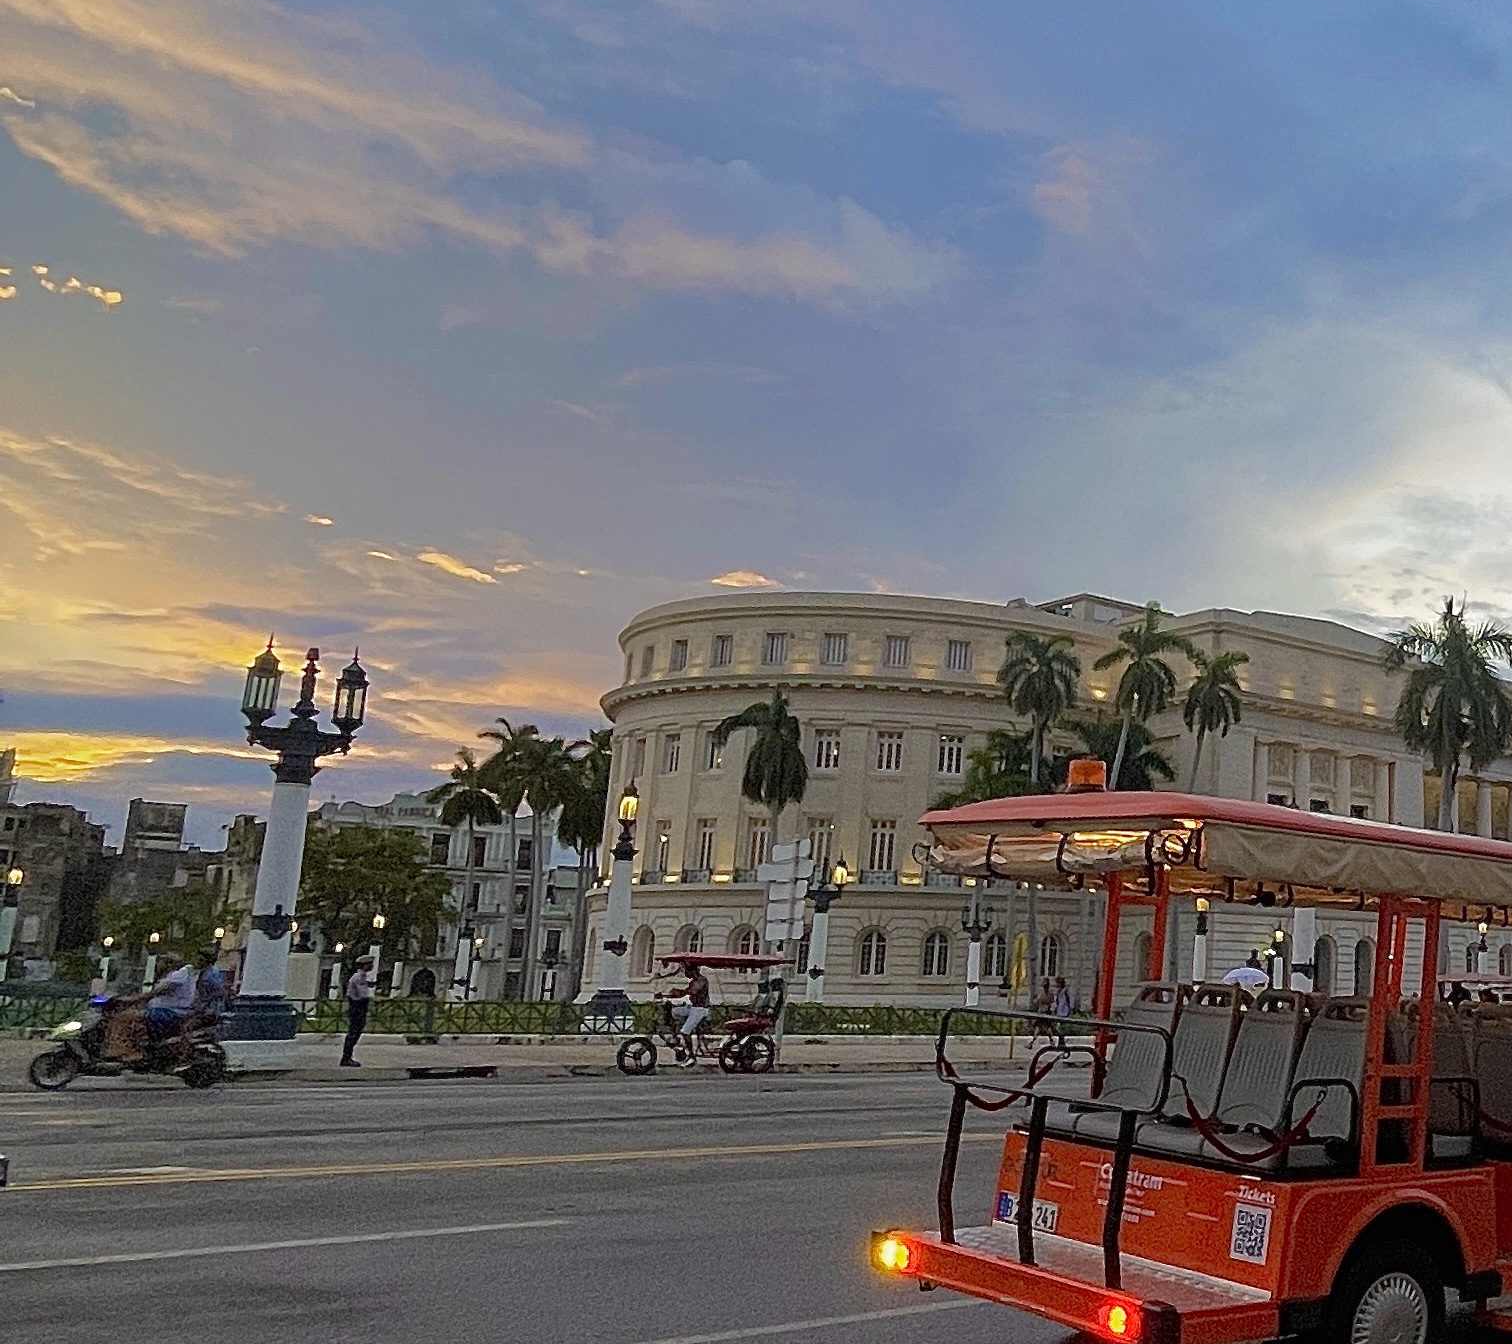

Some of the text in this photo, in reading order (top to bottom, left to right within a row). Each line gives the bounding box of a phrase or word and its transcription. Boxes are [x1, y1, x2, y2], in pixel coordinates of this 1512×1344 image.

[1101, 1163, 1162, 1190] Catram
[1238, 1185, 1275, 1204] Tickets
[1035, 1206, 1056, 1230] 241
